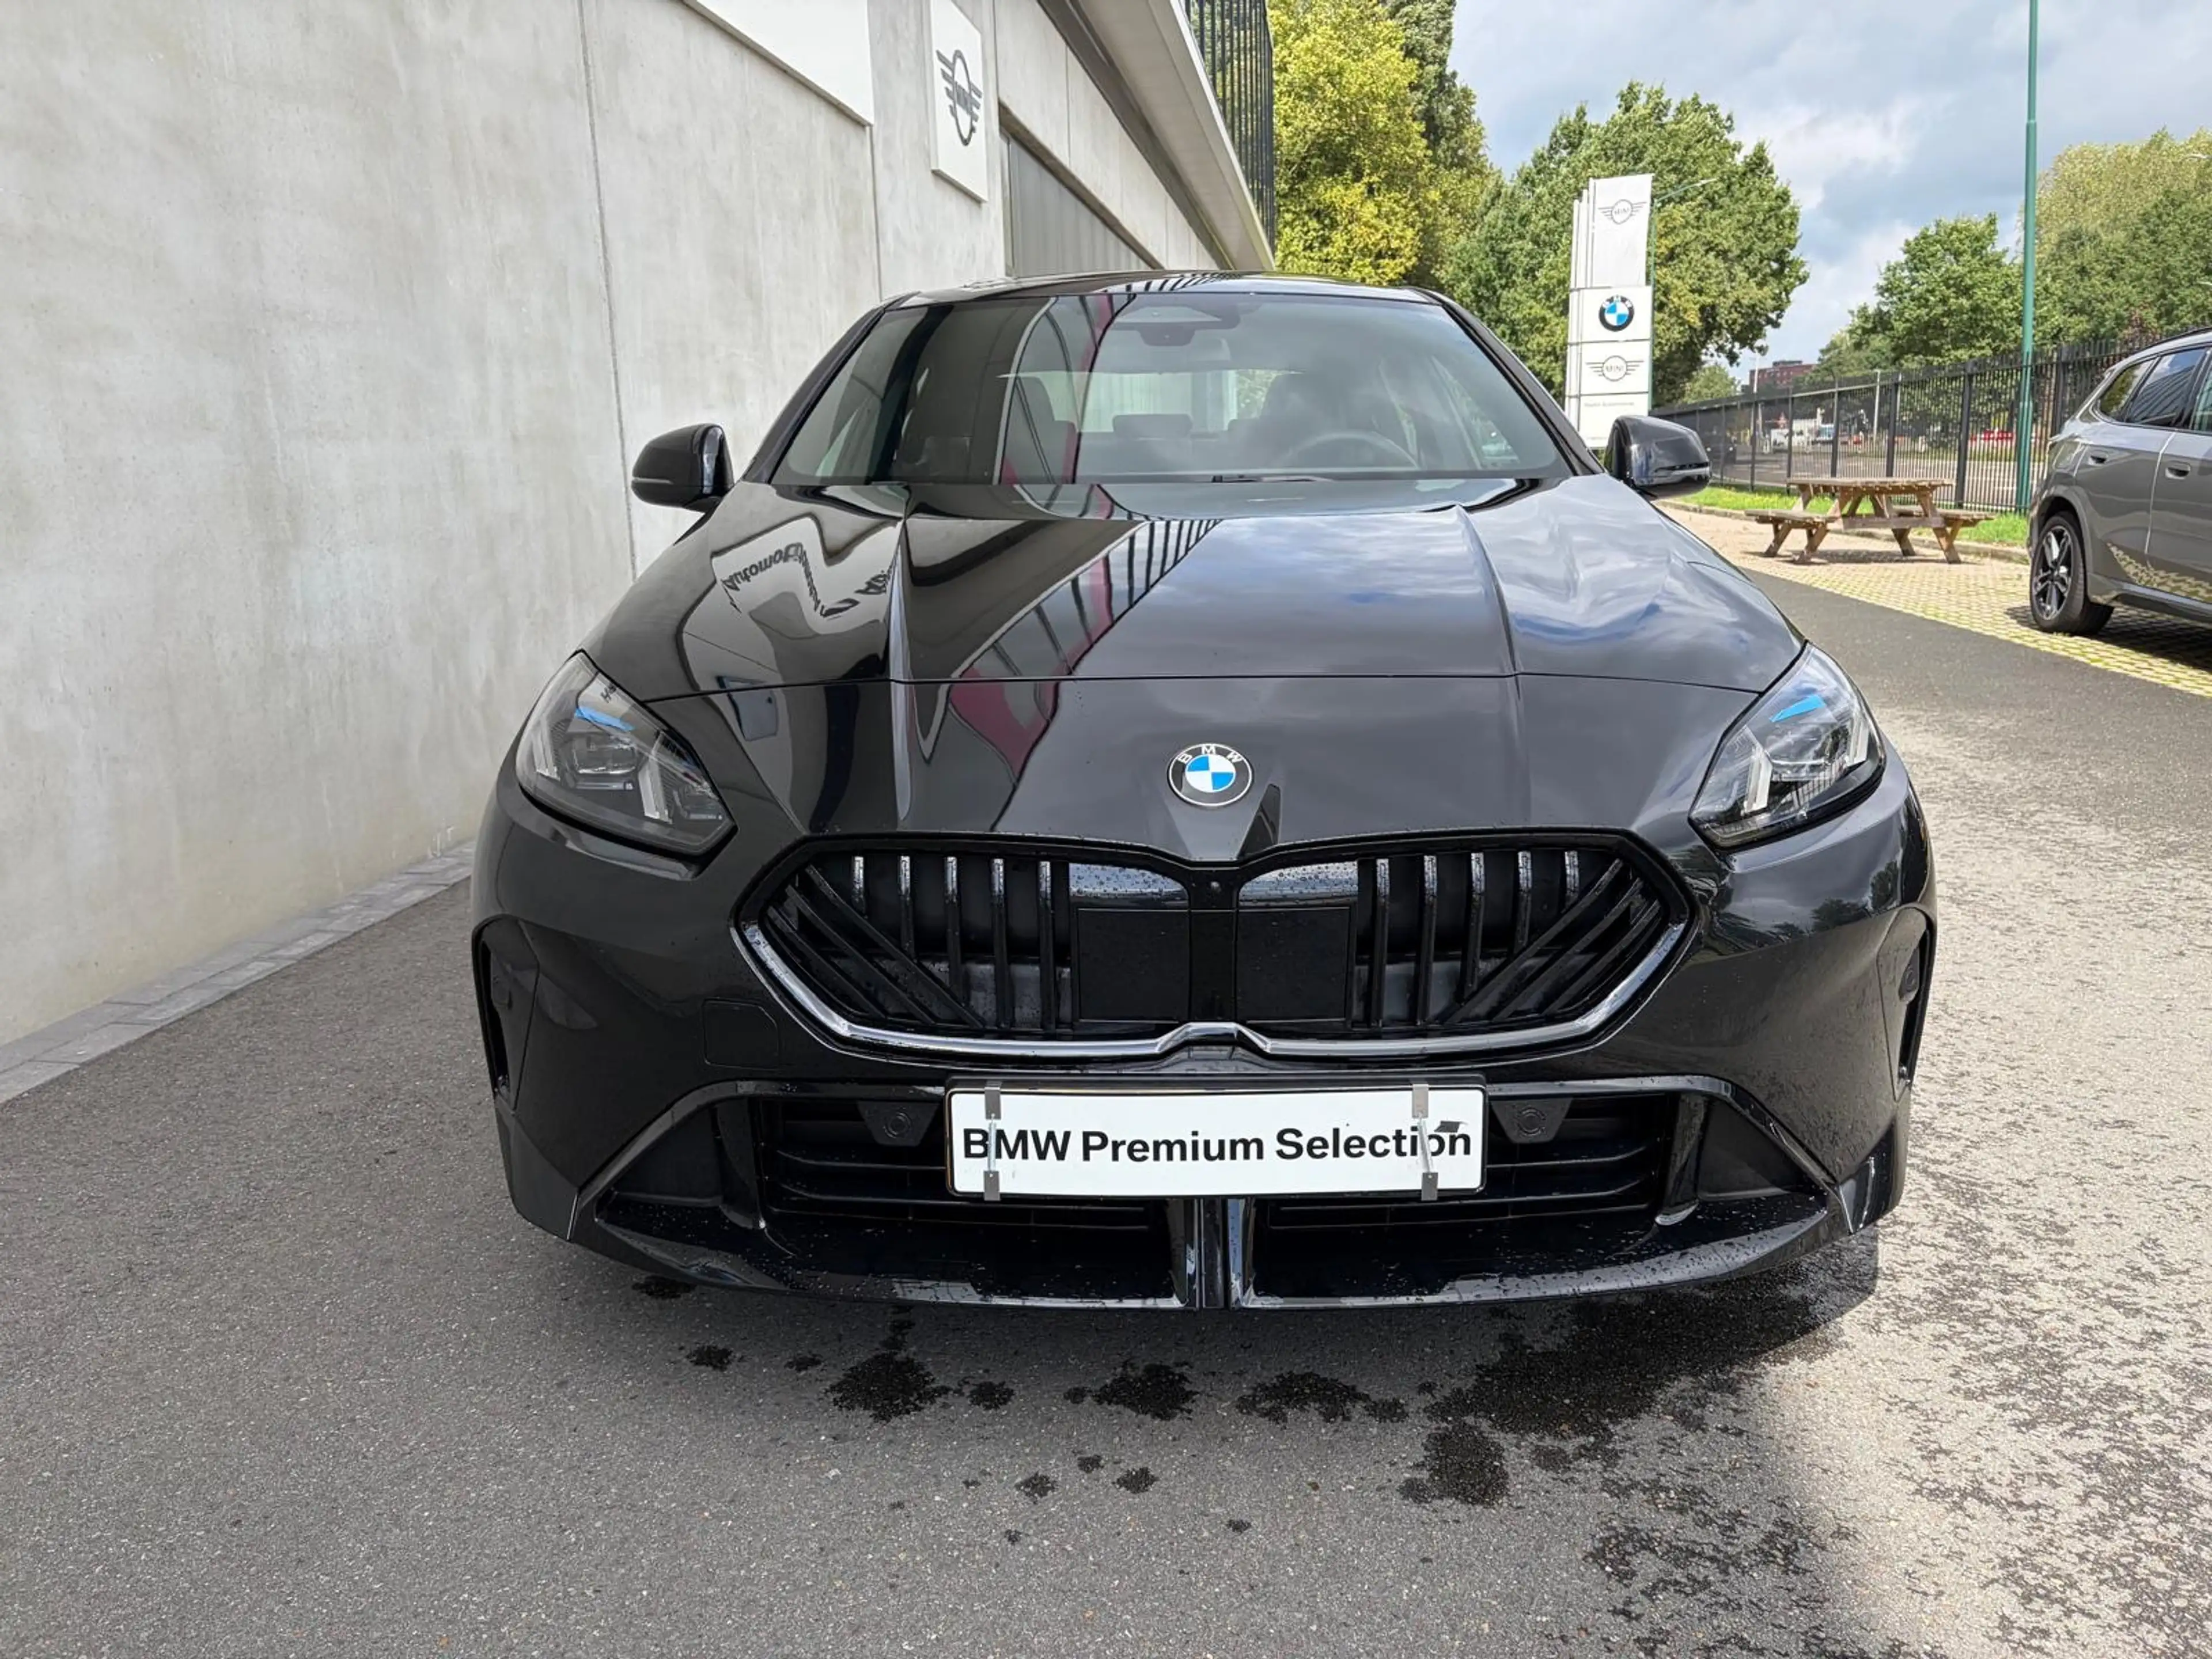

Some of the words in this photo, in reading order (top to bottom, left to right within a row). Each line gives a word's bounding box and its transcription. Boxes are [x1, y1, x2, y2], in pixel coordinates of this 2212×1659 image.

[963, 1128, 1071, 1161] BMW
[1082, 1130, 1264, 1162] Premium
[1276, 1126, 1471, 1160] Selection
